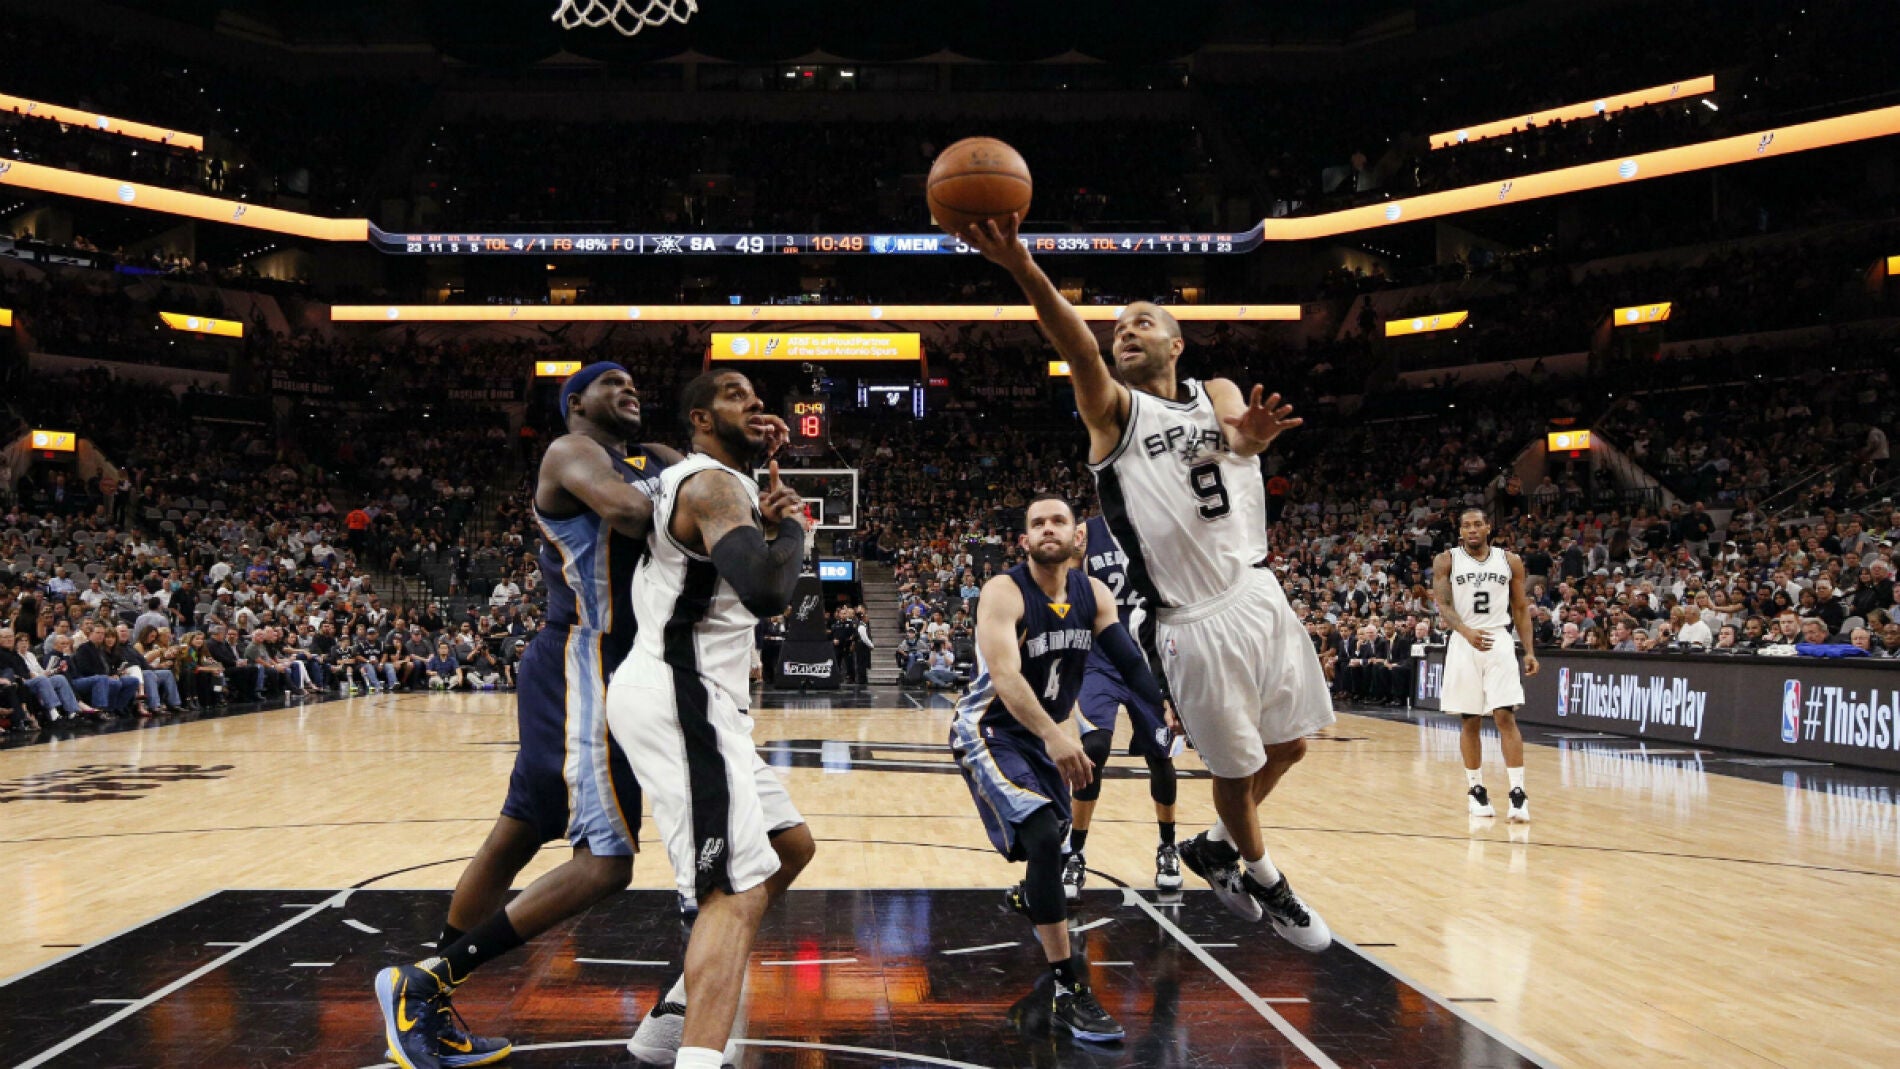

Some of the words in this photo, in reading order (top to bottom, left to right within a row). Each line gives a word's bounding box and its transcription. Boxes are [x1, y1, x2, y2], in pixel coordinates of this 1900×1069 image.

[407, 243, 422, 253] 23
[430, 243, 443, 253] 11
[484, 238, 510, 251] TOL
[553, 238, 573, 251] FG
[575, 238, 608, 251] 48%
[612, 238, 621, 251] F
[689, 237, 716, 252] SA
[735, 236, 764, 253] 49
[785, 235, 795, 246] 3
[811, 236, 862, 252] 10:49
[898, 238, 939, 251] MEM
[1036, 238, 1056, 251] FG
[1057, 238, 1090, 251] 33%
[1092, 238, 1119, 251] TOL
[815, 347, 832, 356] San
[834, 347, 868, 356] Antonio
[870, 347, 897, 358] Spurs
[802, 416, 819, 437] 18
[1144, 425, 1231, 460] SPUR
[1190, 462, 1230, 520] 9
[1456, 572, 1507, 587] SPURS
[1473, 591, 1490, 614] 2
[1043, 658, 1062, 701] 4
[1570, 671, 1708, 740] #ThisIsWhyWePlay
